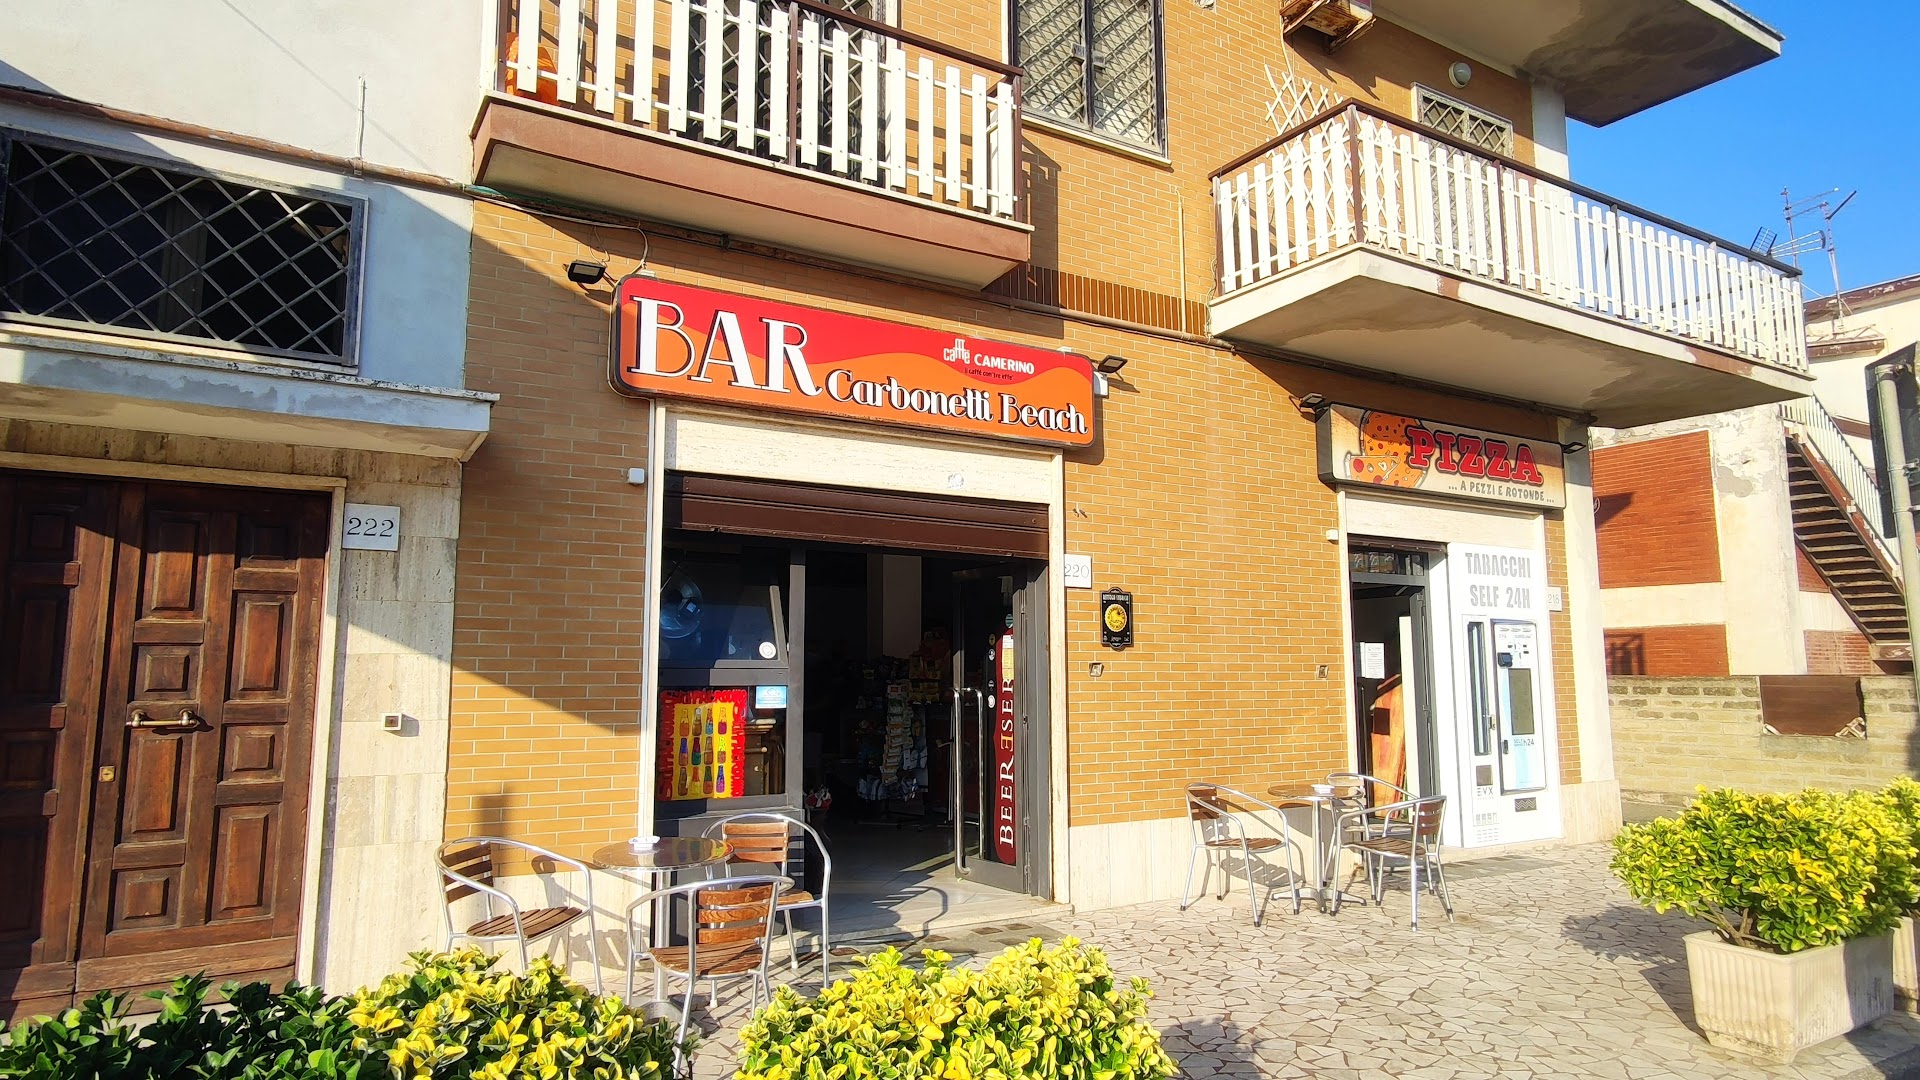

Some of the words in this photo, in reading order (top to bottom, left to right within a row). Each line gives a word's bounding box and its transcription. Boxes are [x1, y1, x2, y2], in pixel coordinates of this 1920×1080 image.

[627, 295, 823, 397] BAR
[973, 353, 1035, 375] CAMERINO
[825, 368, 993, 422] Carbonetti
[998, 392, 1088, 434] Beach
[1405, 427, 1544, 486] PIZZA
[1460, 480, 1467, 492] A
[1469, 482, 1495, 495] PEZZI
[1498, 485, 1503, 496] E
[1505, 487, 1545, 501] ROTONDE
[346, 517, 394, 538] 222
[1064, 563, 1090, 579] 220
[1465, 552, 1531, 578] TABACCHI
[1469, 584, 1499, 607] SELF
[1506, 586, 1531, 609] 24H
